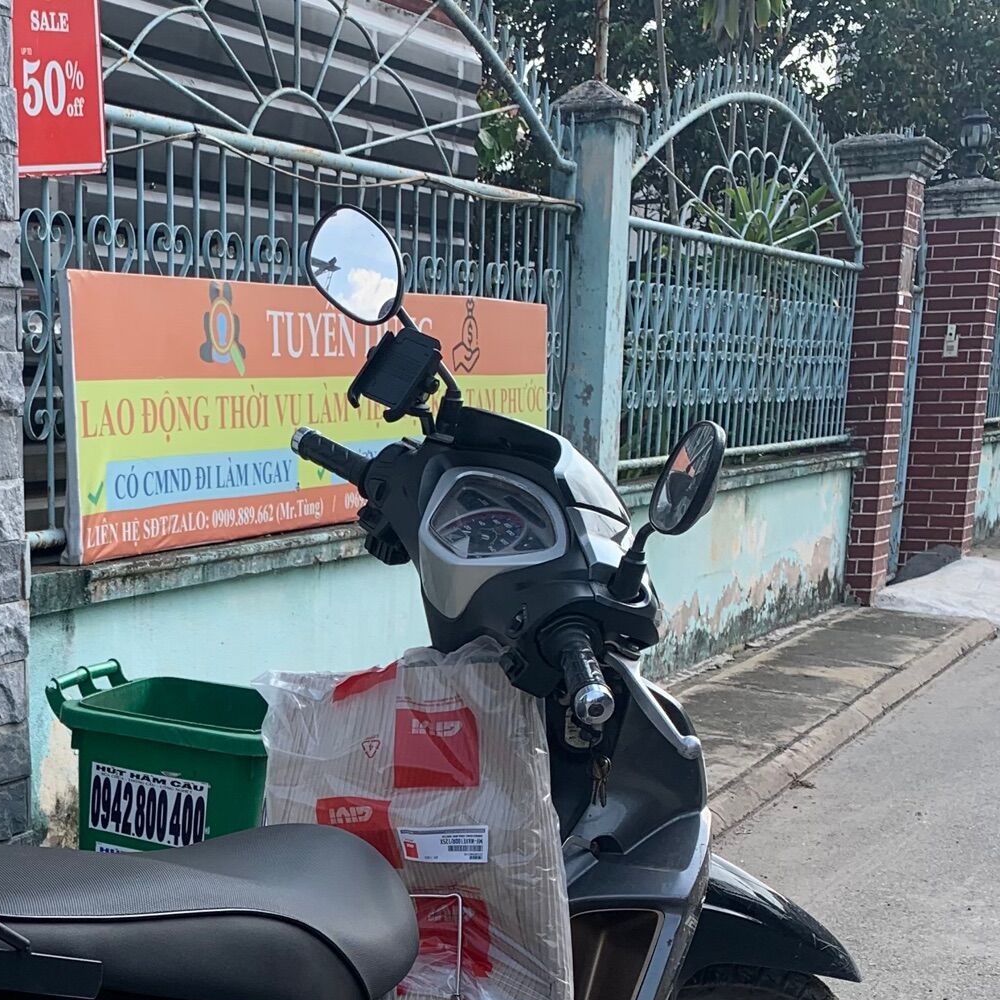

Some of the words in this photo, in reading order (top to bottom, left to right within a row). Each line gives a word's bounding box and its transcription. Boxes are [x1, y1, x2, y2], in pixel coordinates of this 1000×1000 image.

[30, 10, 70, 32] SALE
[66, 97, 85, 118] off
[81, 398, 135, 438] LAO
[141, 390, 210, 443] ĐỘNG
[215, 384, 270, 430] THỜI
[308, 382, 349, 425] LÀM
[501, 379, 545, 413] PHƯỚC
[115, 465, 139, 500] CÓ
[143, 467, 192, 497] CMND
[196, 464, 212, 490] ĐI
[216, 457, 249, 489] LÀM
[252, 459, 292, 485] NGAY
[87, 517, 119, 549] LIÊN
[122, 517, 140, 547] HỆ
[212, 503, 274, 529] 0909.889.662
[90, 774, 206, 847] 0942.800.400
[328, 806, 374, 825] GIVI
